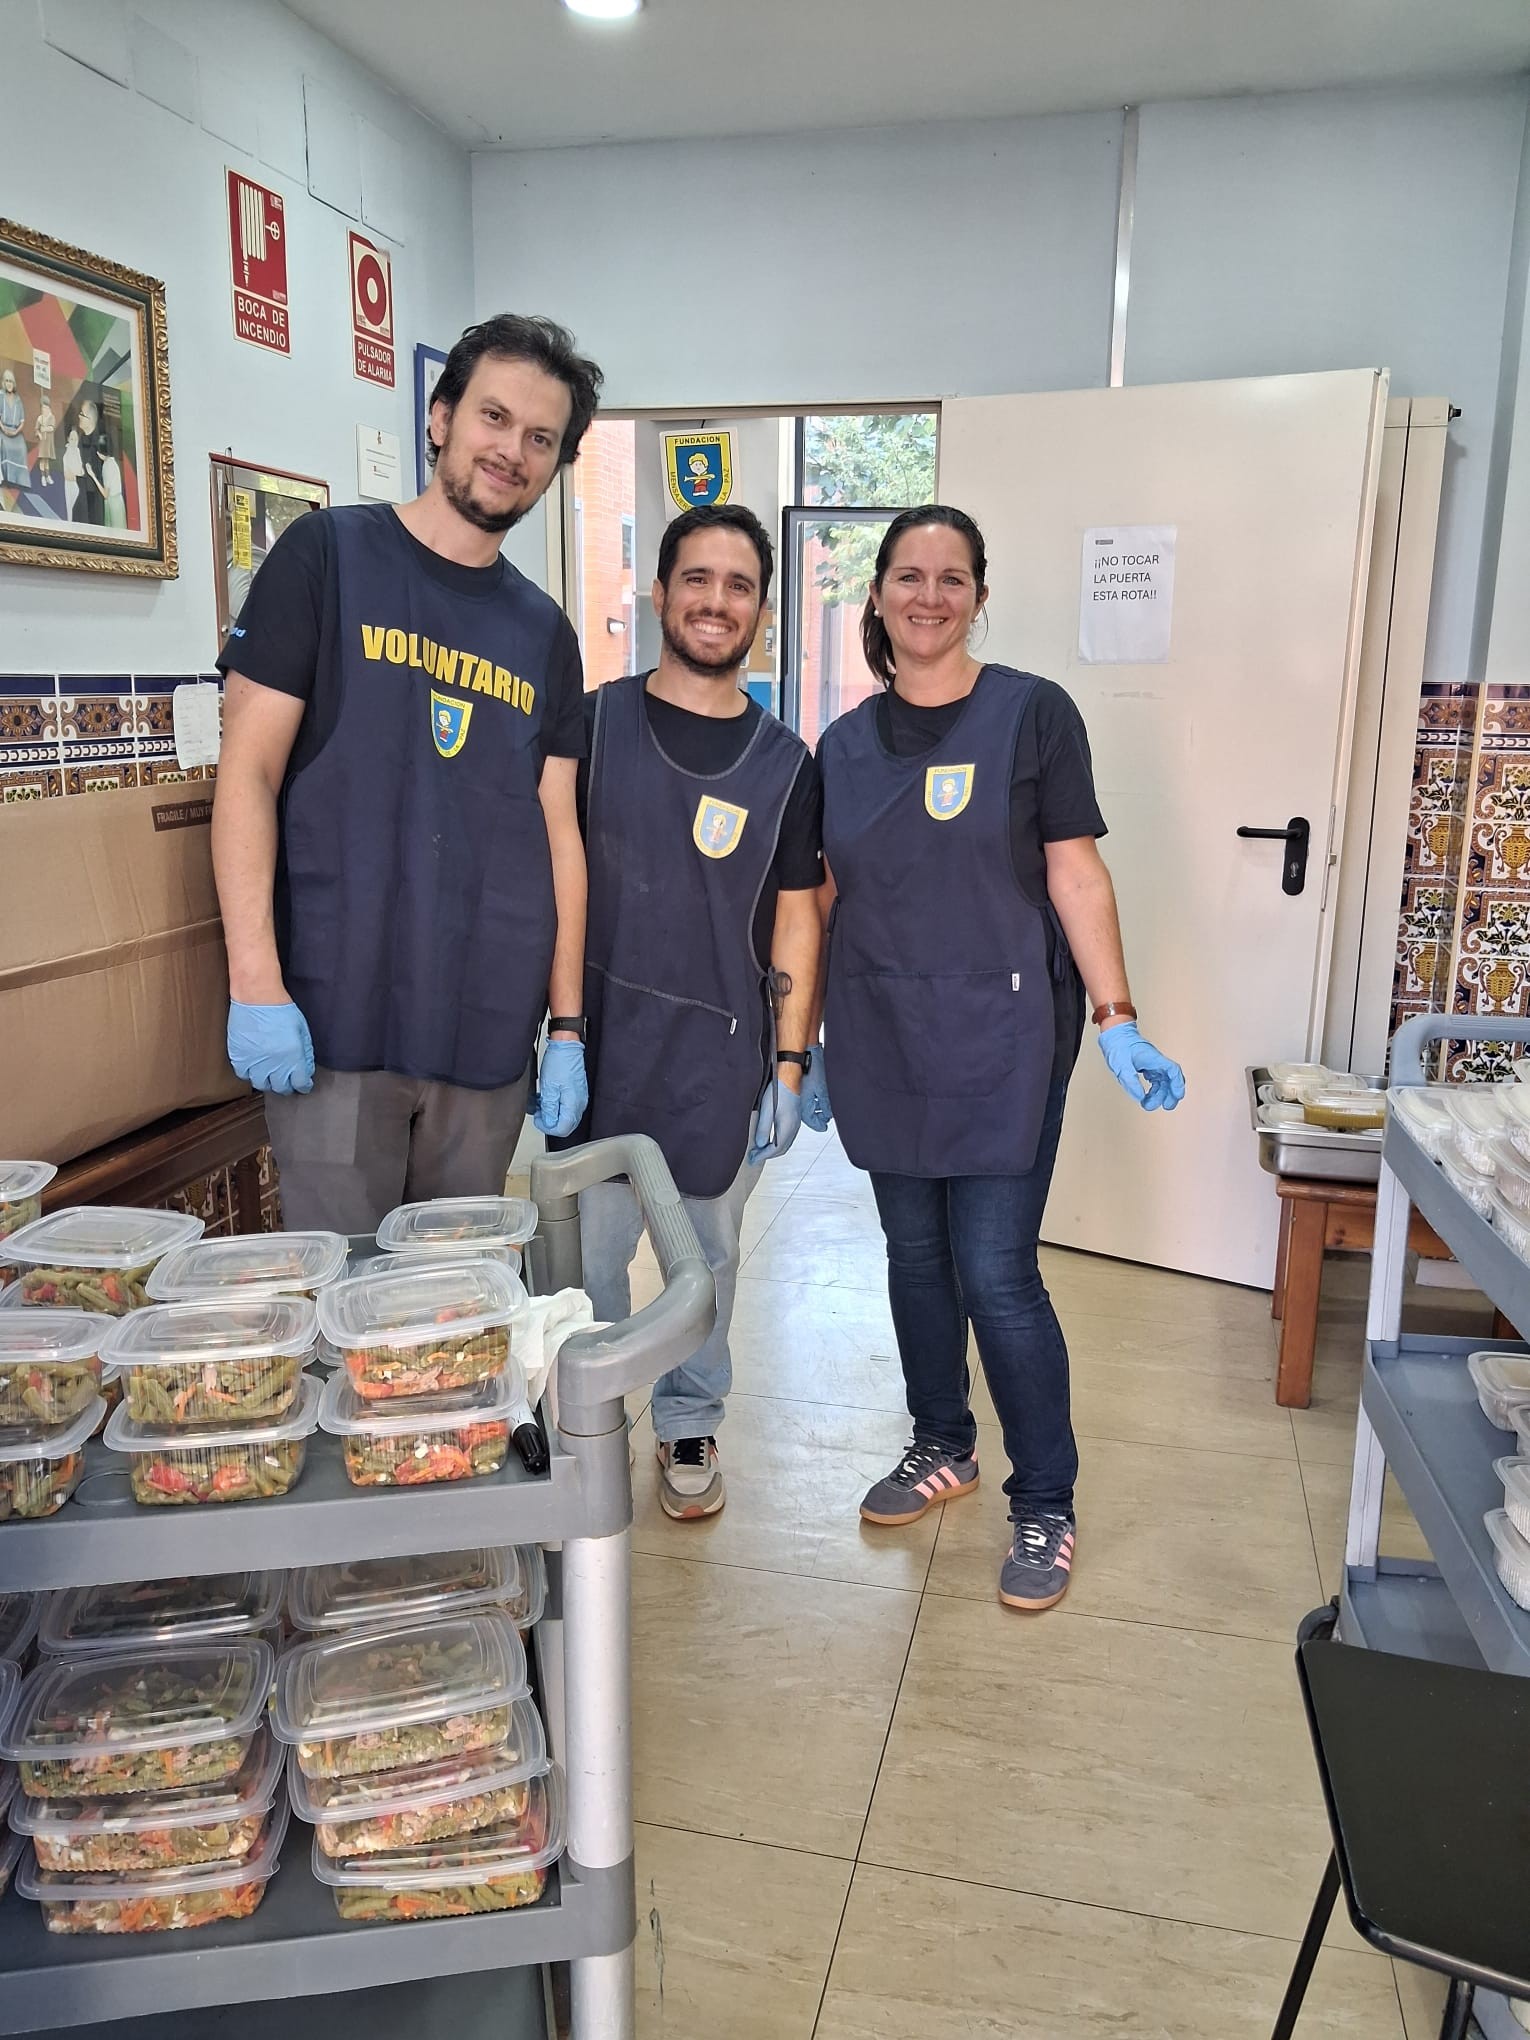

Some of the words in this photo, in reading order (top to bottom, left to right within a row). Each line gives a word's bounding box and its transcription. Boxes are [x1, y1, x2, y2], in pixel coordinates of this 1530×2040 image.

[237, 295, 267, 321] BOCA
[272, 309, 286, 328] DE
[239, 317, 286, 348] INCENDIO
[357, 341, 392, 365] PULSADOR
[357, 358, 367, 373] DE
[367, 362, 393, 383] ALARMA
[674, 436, 720, 445] FUNDACION
[1121, 554, 1159, 565] TOCAR
[1093, 573, 1107, 584] LA
[1109, 572, 1152, 584] PUERTA
[1093, 590, 1119, 601] ESTA
[1121, 589, 1157, 601] ROTA!!
[361, 623, 536, 716] VOLUNTARIO
[156, 808, 185, 824] FRAGILE
